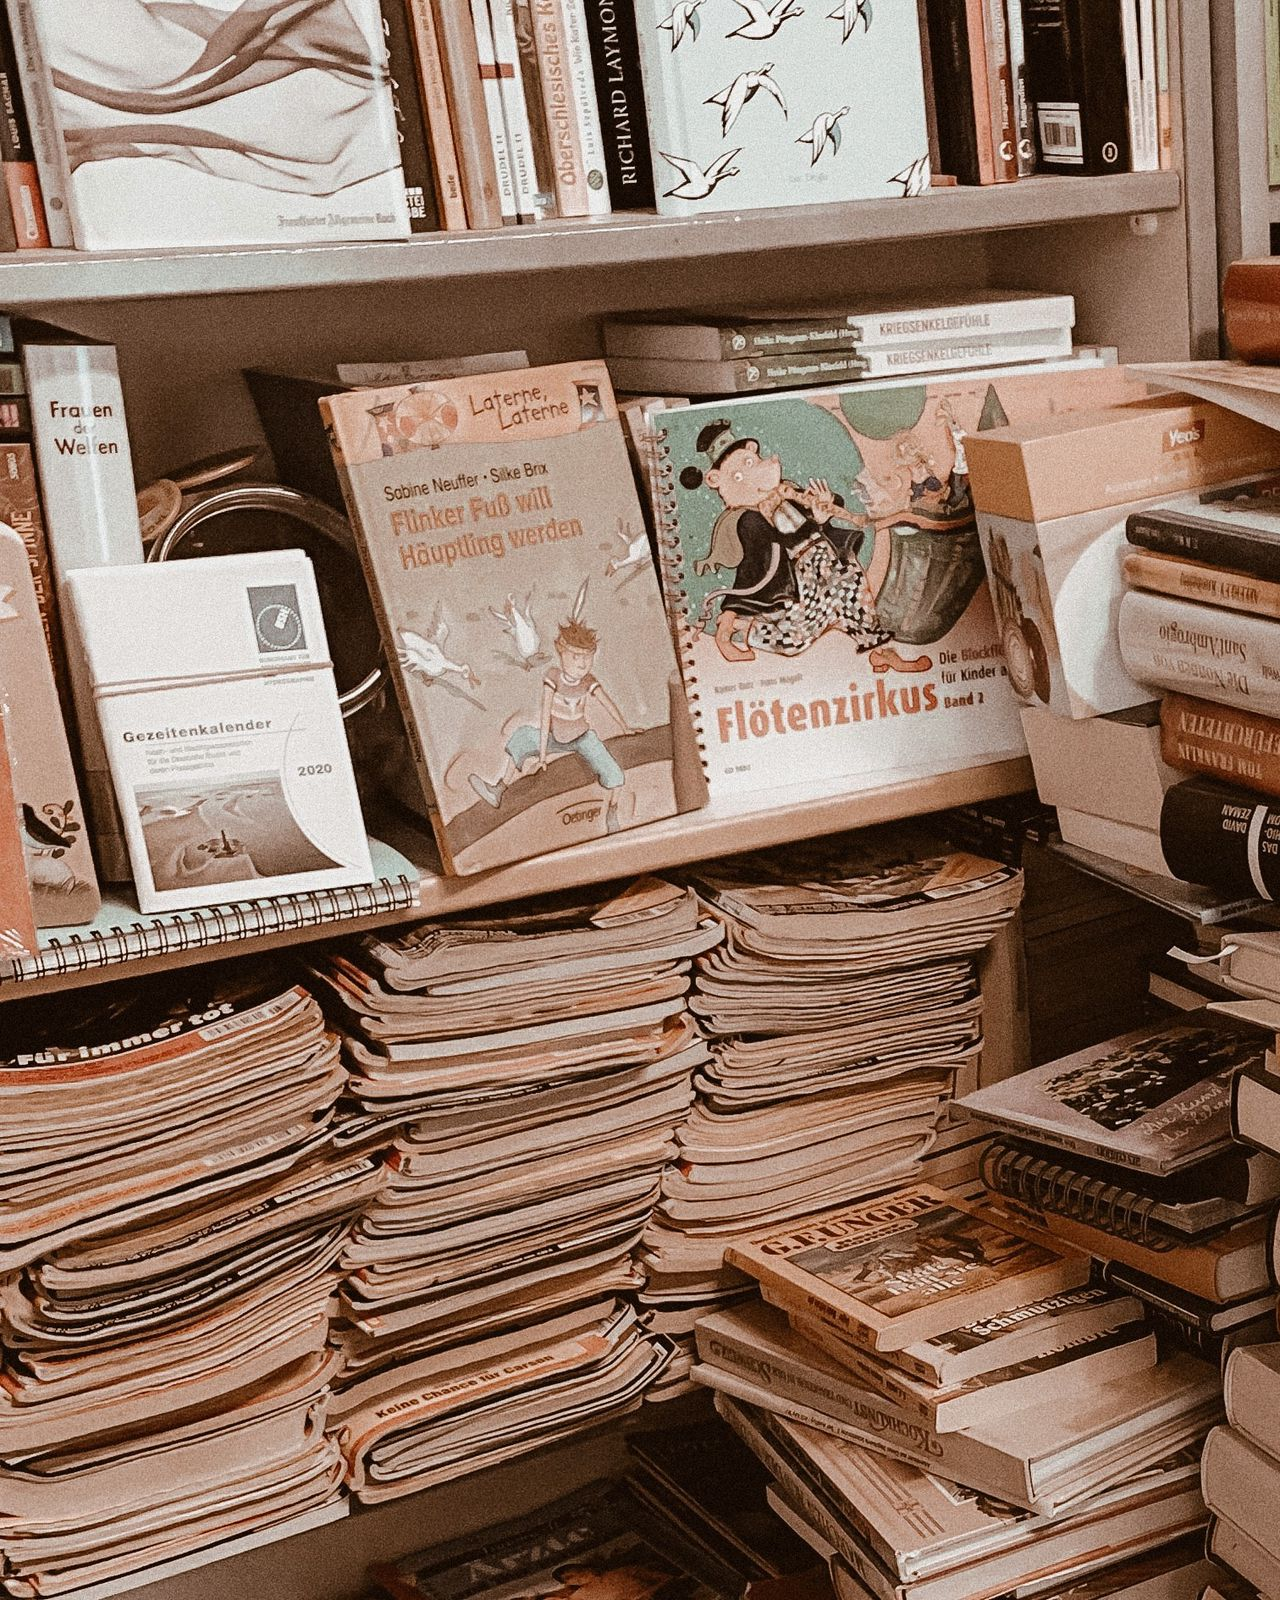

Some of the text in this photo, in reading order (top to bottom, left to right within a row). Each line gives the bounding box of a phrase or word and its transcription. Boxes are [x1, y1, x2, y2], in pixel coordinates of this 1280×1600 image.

[542, 23, 576, 186] Oberschlesisches
[611, 90, 638, 184] RICHARD
[468, 385, 548, 416] Laterne,
[497, 402, 570, 431] Laterne
[383, 462, 549, 501] Sabine Neuffer Silke Brix
[390, 485, 554, 537] Flinker Fuß will
[399, 517, 583, 571] Häuptling werden
[939, 651, 958, 666] Die
[940, 666, 997, 684] für Kinder
[717, 678, 939, 744] Flötenzirkus
[944, 692, 976, 709] Band
[123, 719, 272, 743] Gezeitenkalender
[297, 763, 333, 777] 2020
[1221, 804, 1252, 821] ZEMAN
[1222, 820, 1247, 834] DAVID
[1262, 840, 1279, 855] DAS
[80, 1020, 183, 1059] immer
[188, 1002, 235, 1026] tot
[971, 1288, 1107, 1337] Schmutzigen
[375, 1353, 554, 1419] Keine Chance für Carson
